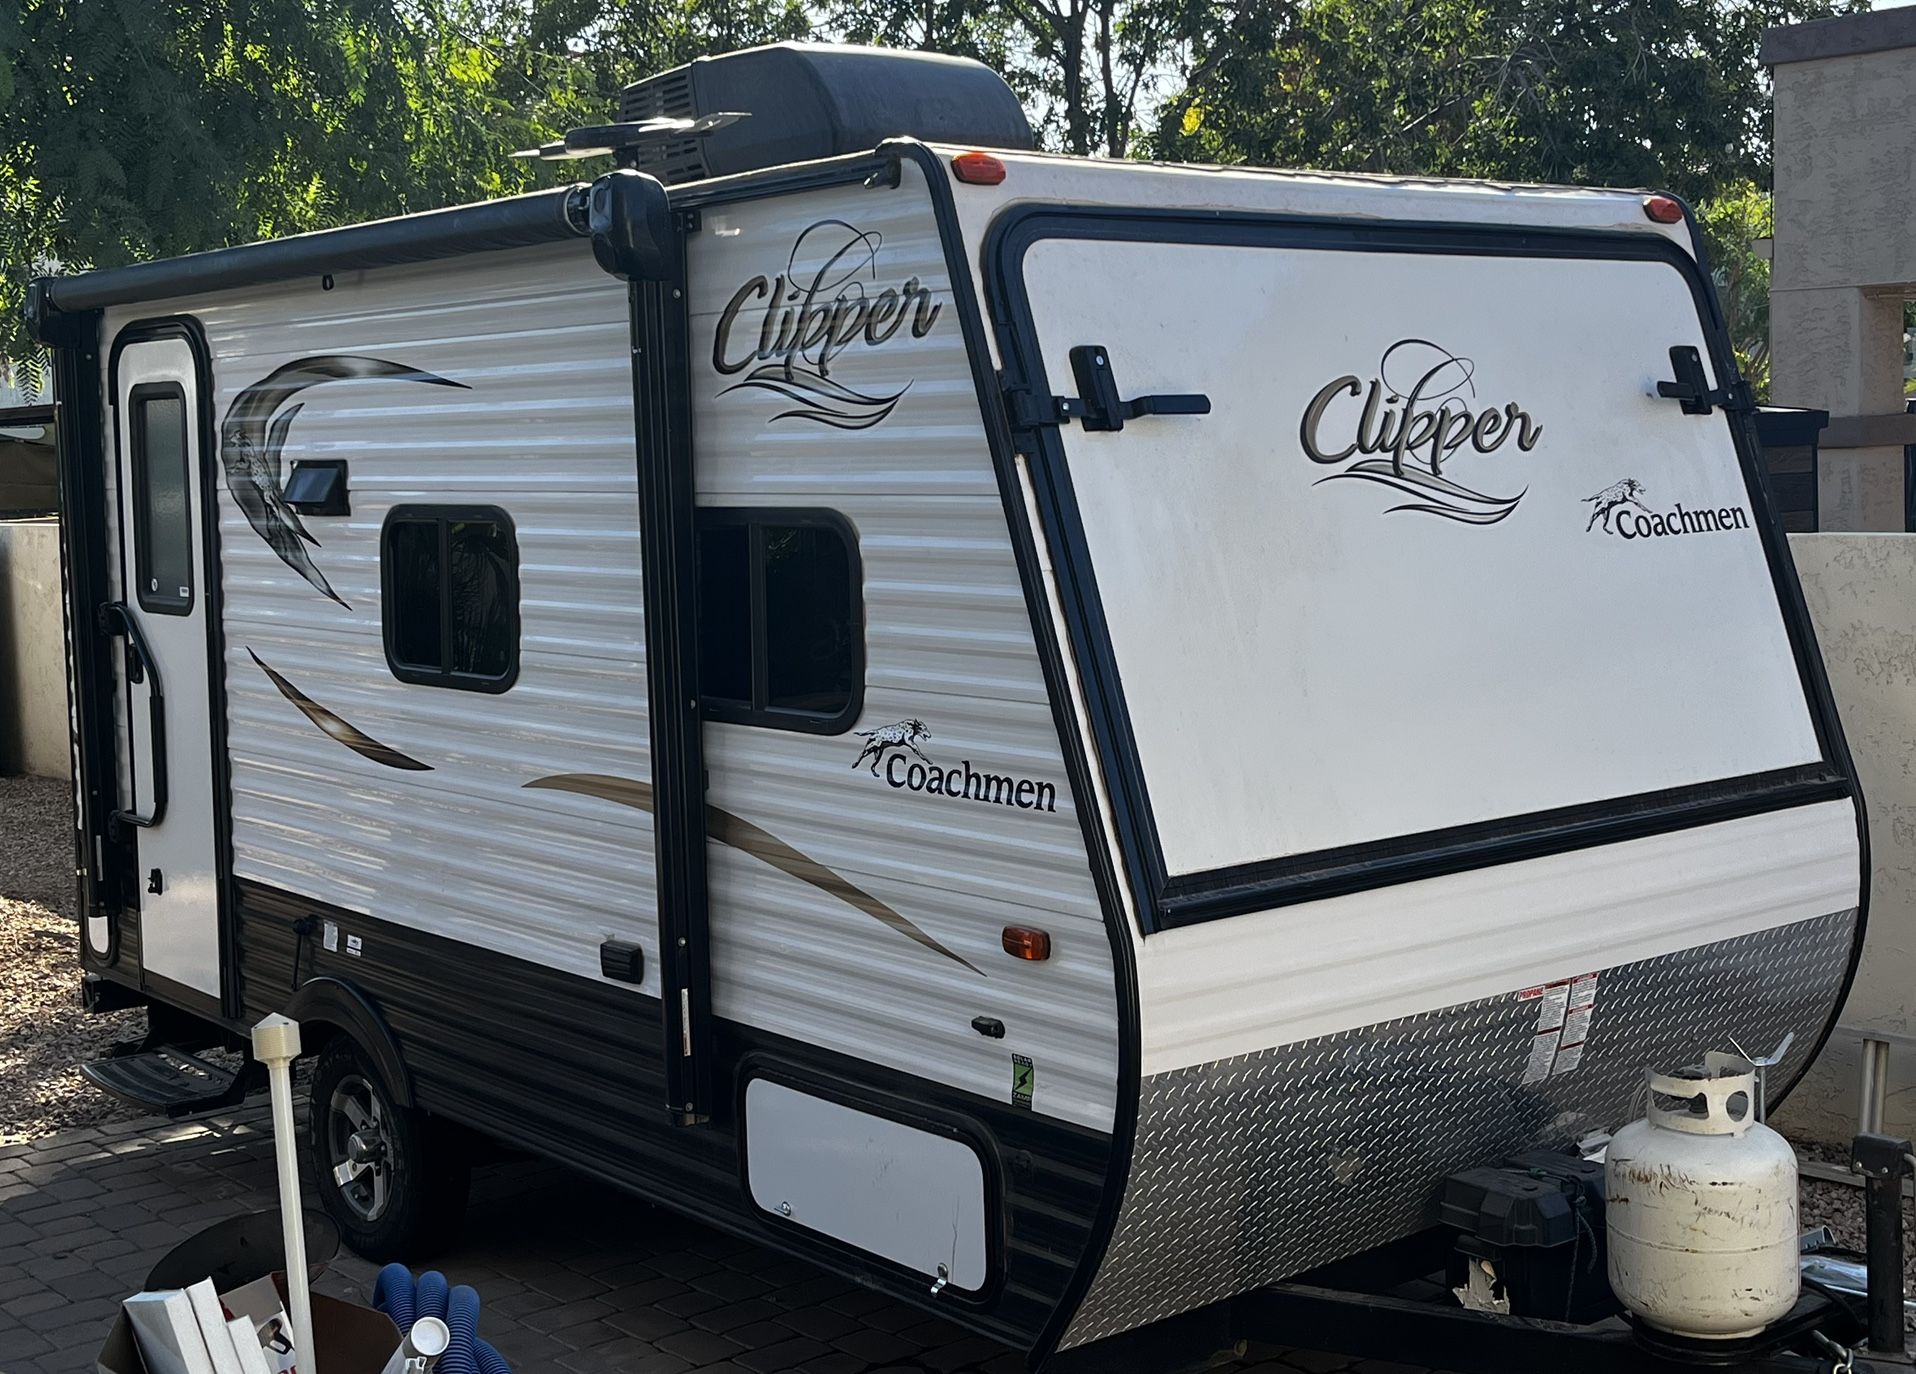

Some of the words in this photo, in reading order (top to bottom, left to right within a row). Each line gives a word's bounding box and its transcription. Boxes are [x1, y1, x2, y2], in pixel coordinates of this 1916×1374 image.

[712, 219, 943, 381] Clipper
[1300, 338, 1544, 476] Clipper
[1615, 503, 1751, 540] Coachmen
[886, 753, 1058, 813] Coachmen
[1519, 987, 1544, 1000] PROPANE
